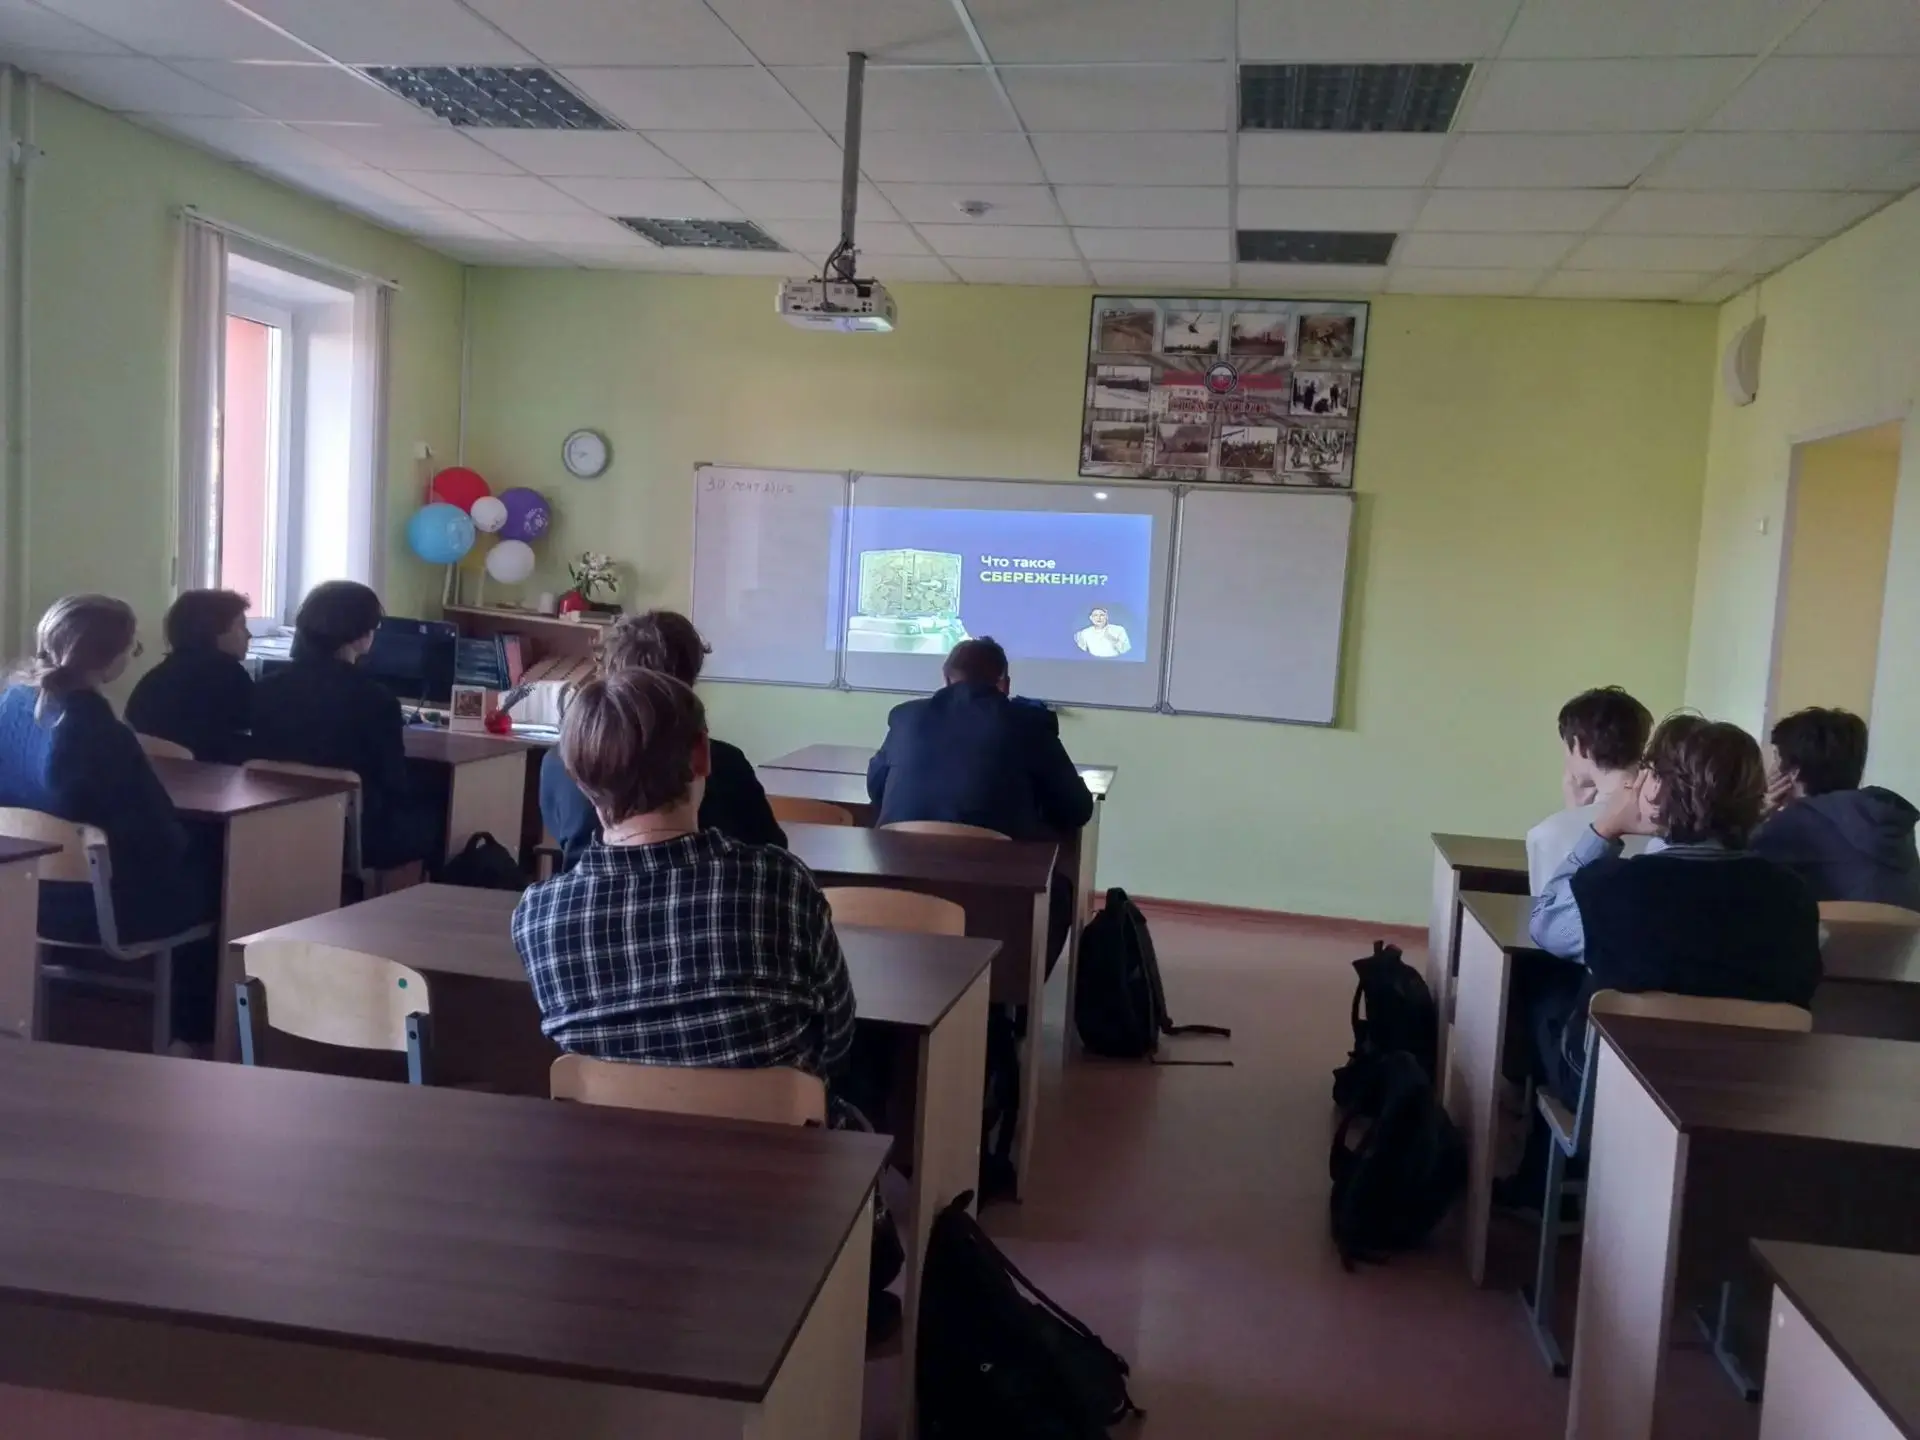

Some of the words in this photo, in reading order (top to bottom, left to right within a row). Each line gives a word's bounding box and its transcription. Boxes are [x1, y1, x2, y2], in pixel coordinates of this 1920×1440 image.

[980, 554, 1010, 567] Что
[1012, 557, 1056, 569] такое
[979, 571, 1109, 586] СБЕРЕЖЕНИЯ?
